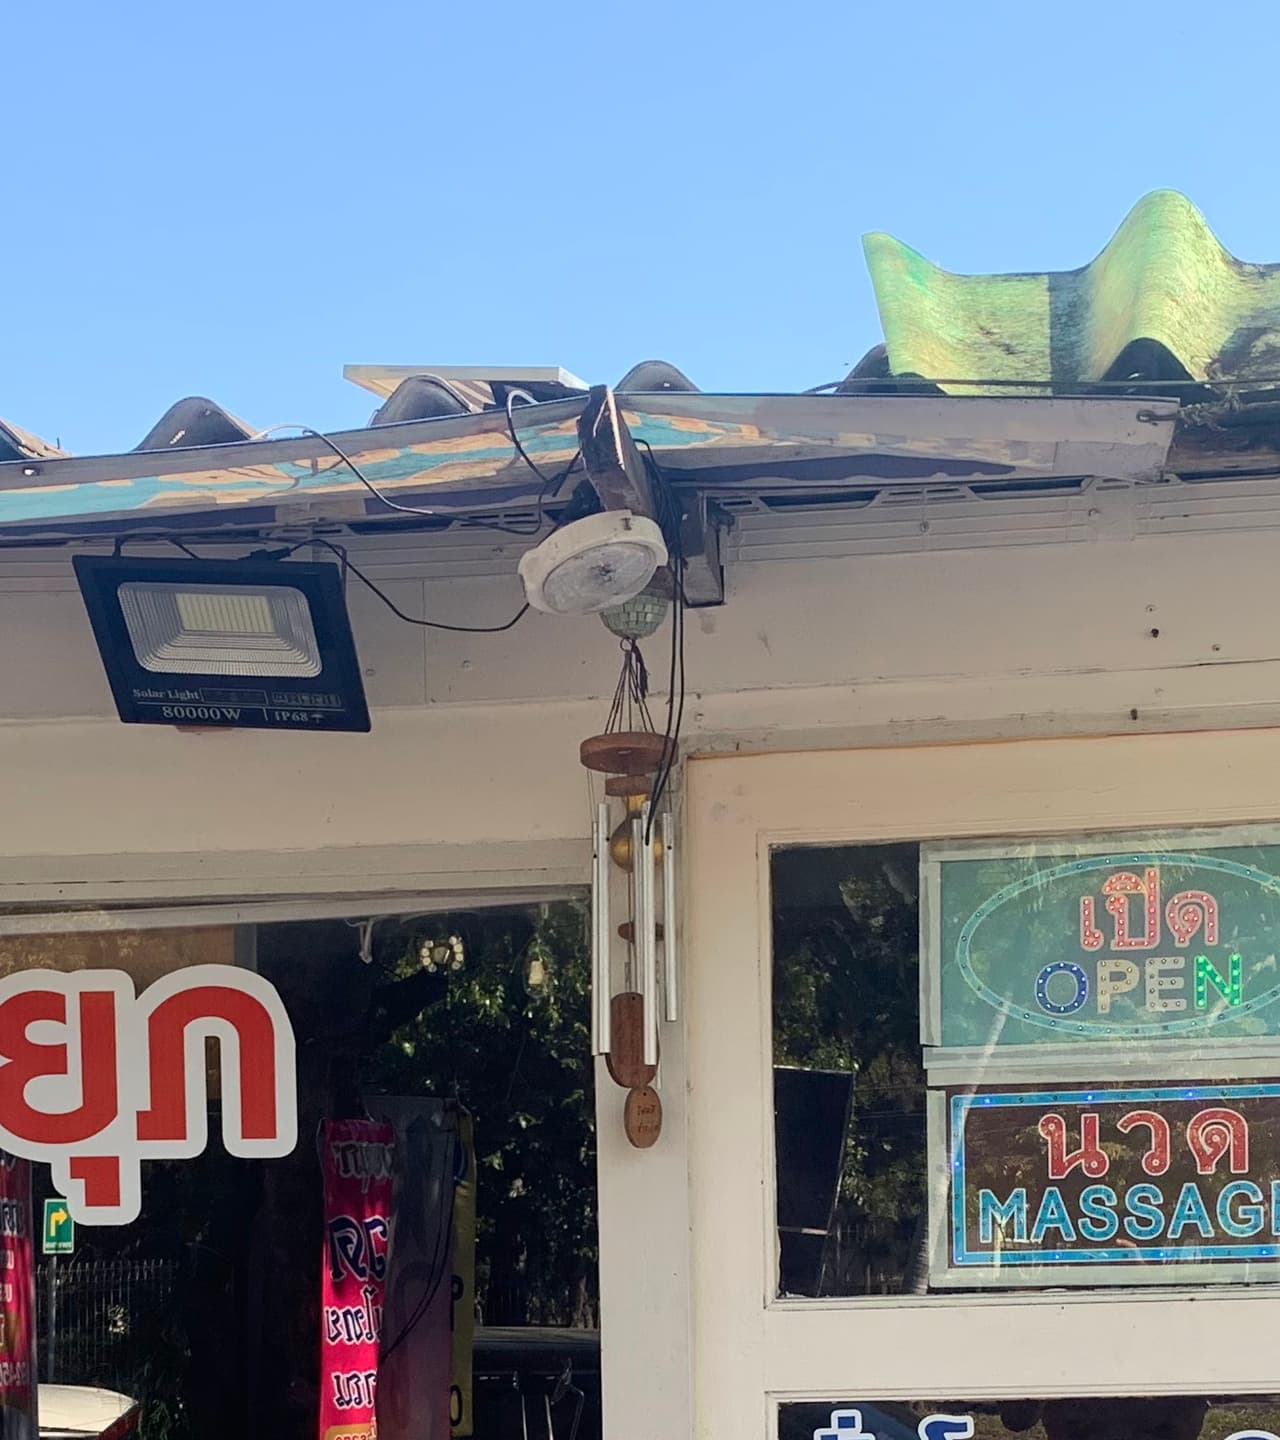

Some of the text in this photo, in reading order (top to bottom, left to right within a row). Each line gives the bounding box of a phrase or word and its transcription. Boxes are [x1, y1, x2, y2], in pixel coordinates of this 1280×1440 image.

[132, 688, 200, 701] Solar Light
[275, 710, 309, 722] IP68
[1080, 867, 1219, 952] เปิด
[1035, 953, 1242, 1015] OPEN
[1038, 1107, 1250, 1180] นวด
